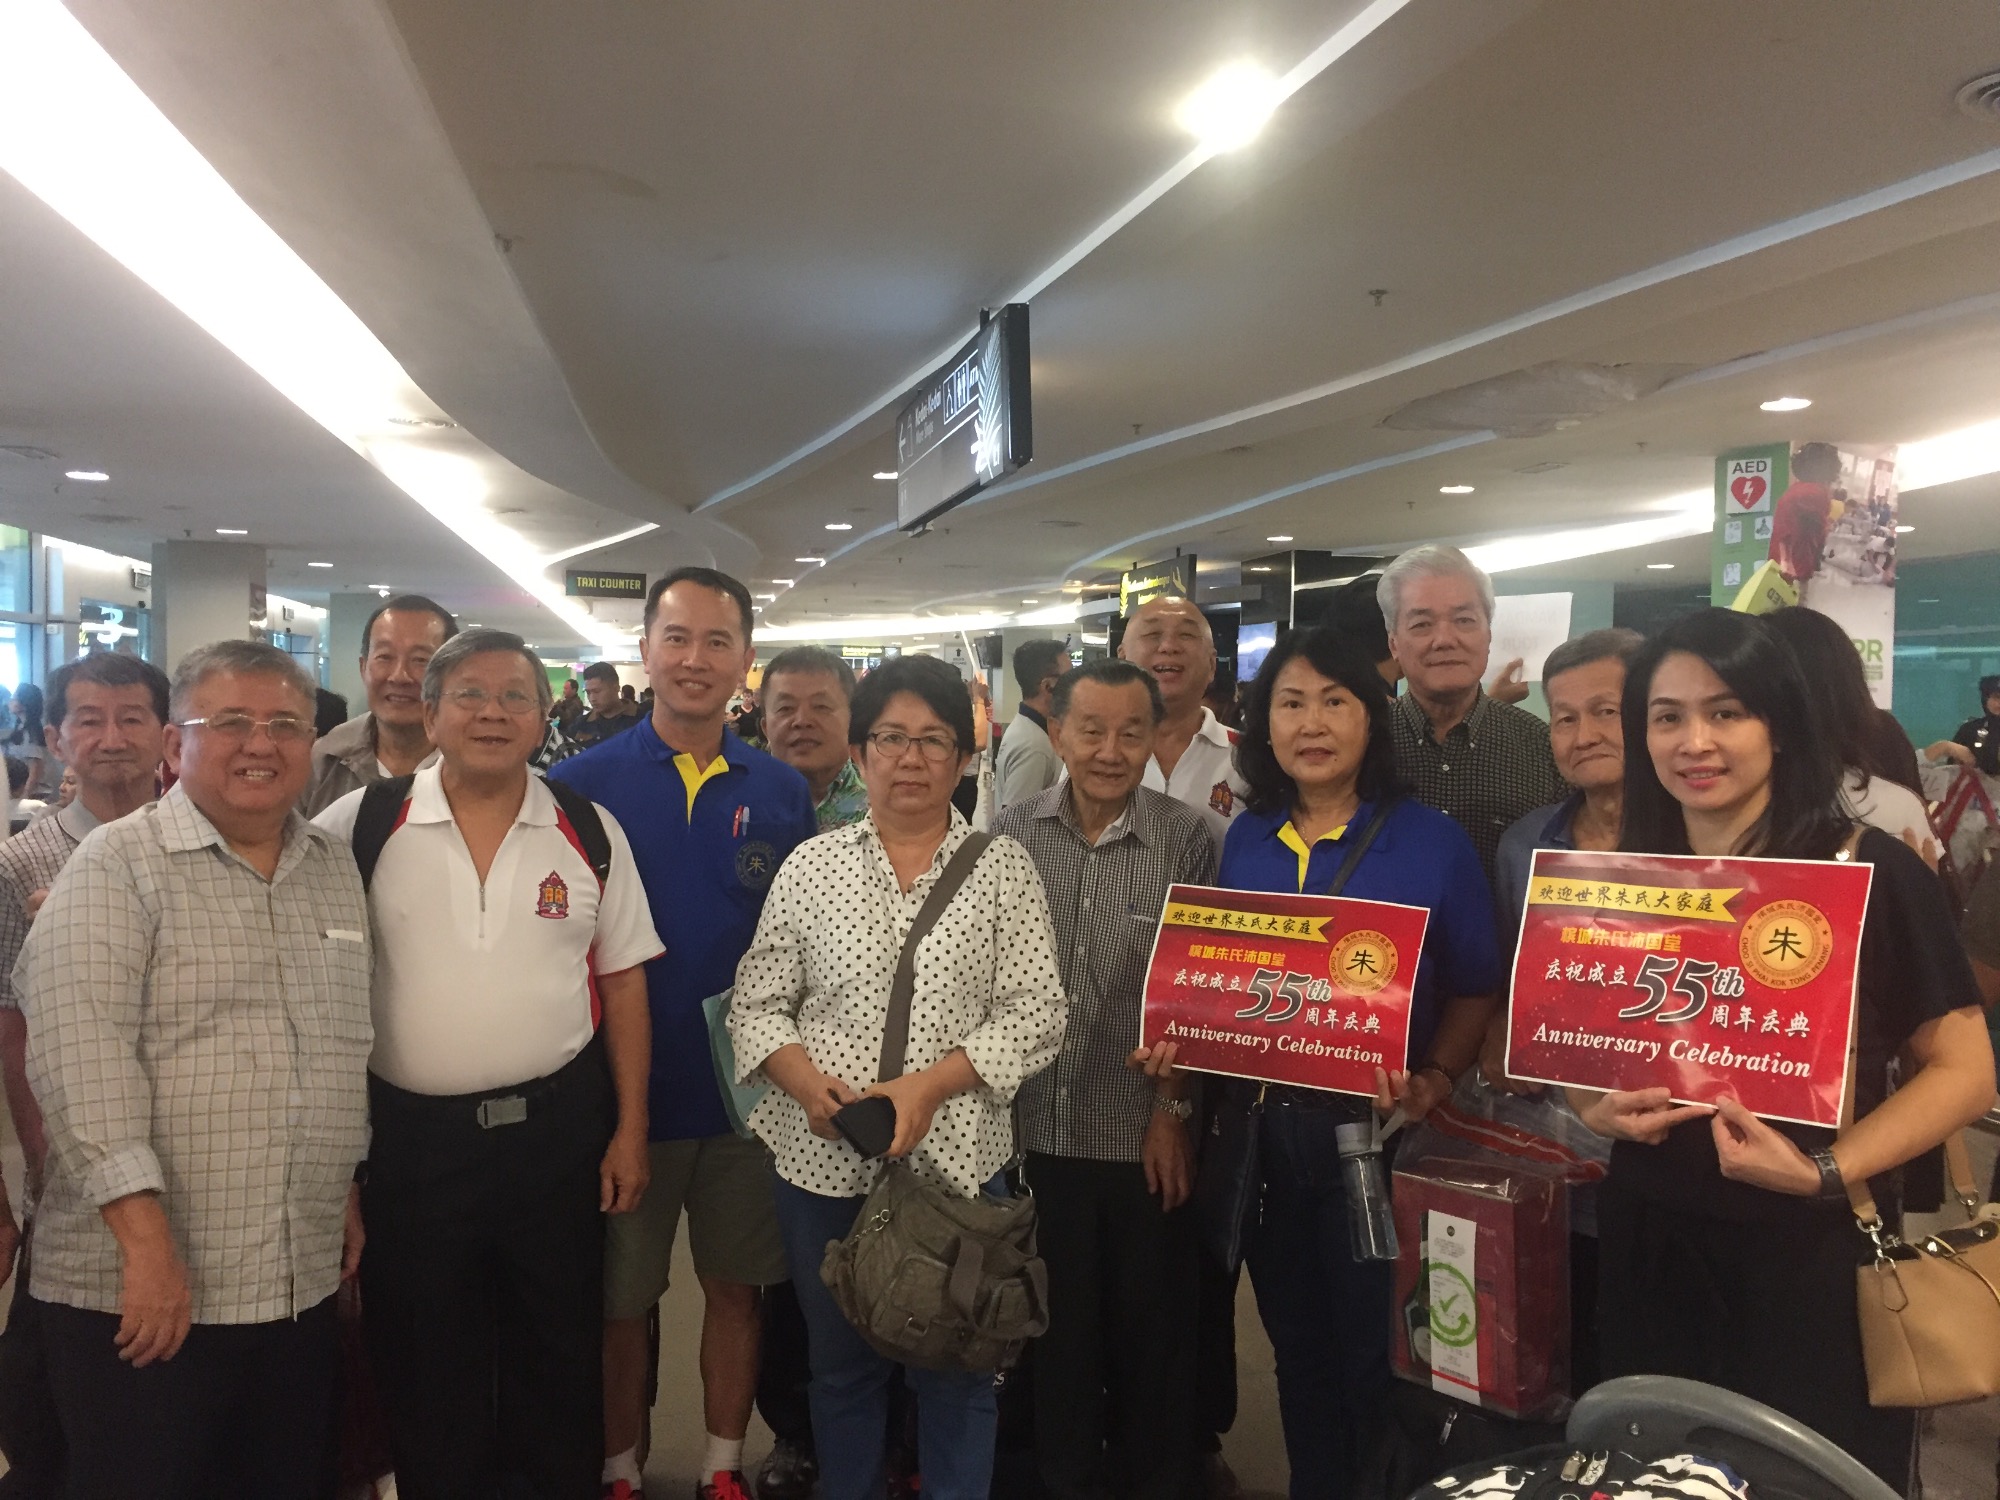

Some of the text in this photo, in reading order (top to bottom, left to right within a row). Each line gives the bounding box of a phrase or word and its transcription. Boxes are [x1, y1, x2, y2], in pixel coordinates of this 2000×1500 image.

[1732, 461, 1767, 474] AED
[577, 577, 641, 589] TAXI COUNTER
[747, 856, 766, 875] 朱
[1538, 883, 1716, 914] 欢迎世界朱氏大家庭
[1171, 910, 1313, 936] 欢迎世界朱氏大家庭
[1763, 926, 1806, 961] 朱
[1345, 949, 1378, 975] 朱
[1741, 937, 1750, 959] CHOO
[1771, 978, 1787, 986] KOK
[1790, 973, 1812, 986] TONG
[1812, 944, 1830, 973] PENANG
[1173, 968, 1381, 1035] 庆祝成立 55th 周年庆典
[1544, 954, 1811, 1039] 庆祝成立 55th 周年庆典
[1164, 1020, 1384, 1065] Anniversary Celebration
[1532, 1022, 1812, 1078] Anniversary Celebration
